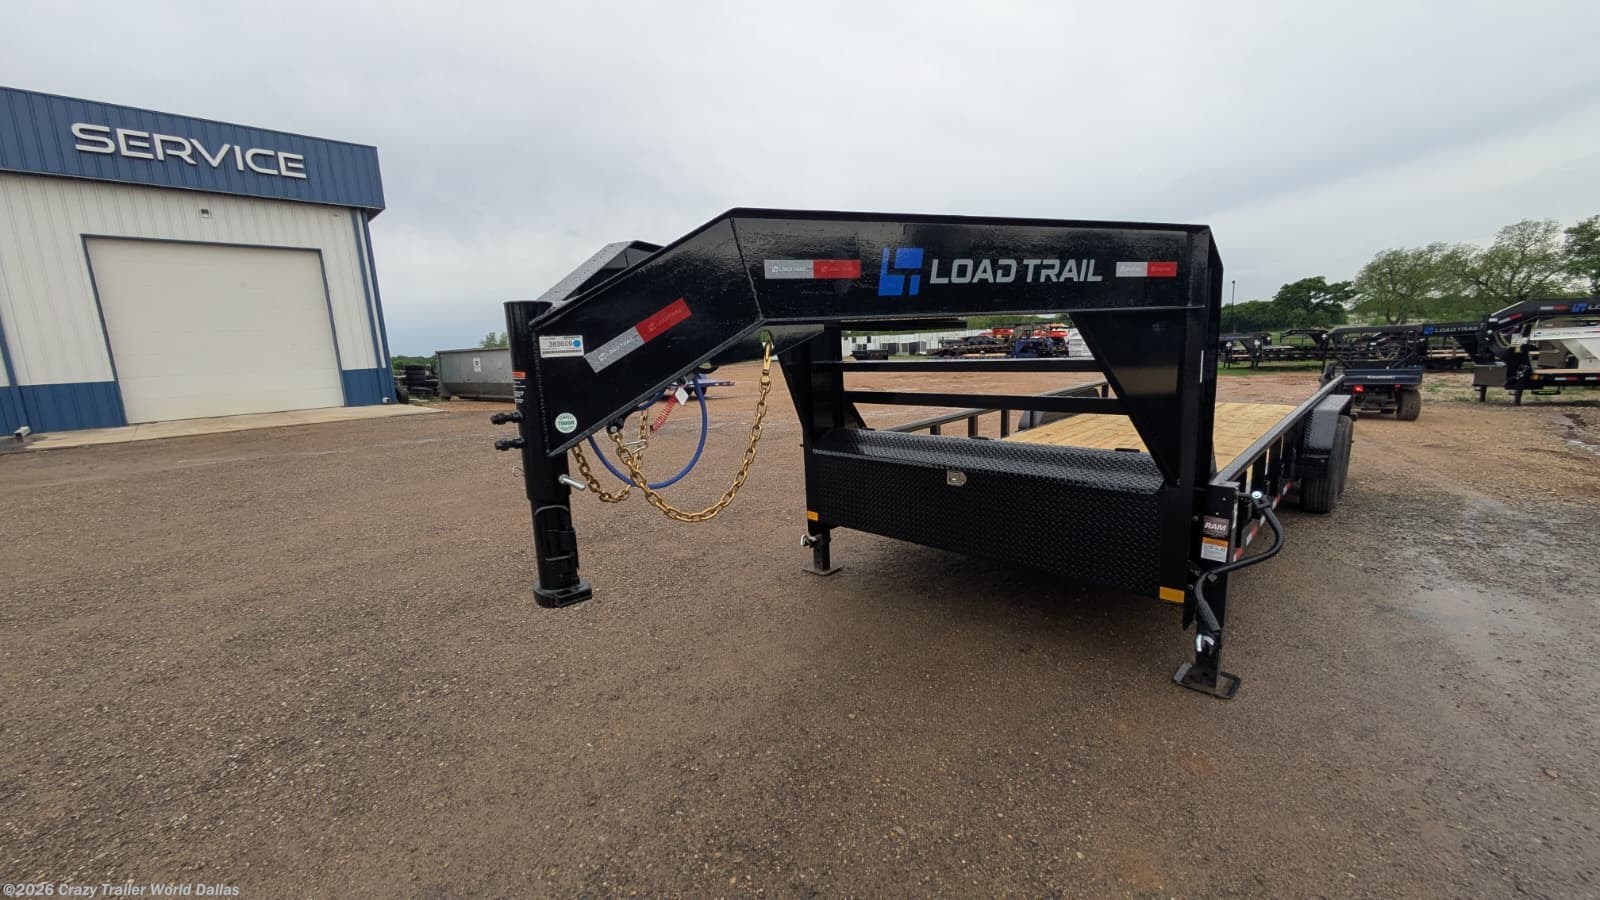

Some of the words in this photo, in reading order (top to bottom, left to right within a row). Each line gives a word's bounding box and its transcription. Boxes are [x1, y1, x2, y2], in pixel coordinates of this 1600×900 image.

[71, 122, 308, 179] SERVICE
[929, 258, 1018, 285] LOAD
[1023, 258, 1103, 283] TRAIL
[1204, 522, 1227, 531] RAM
